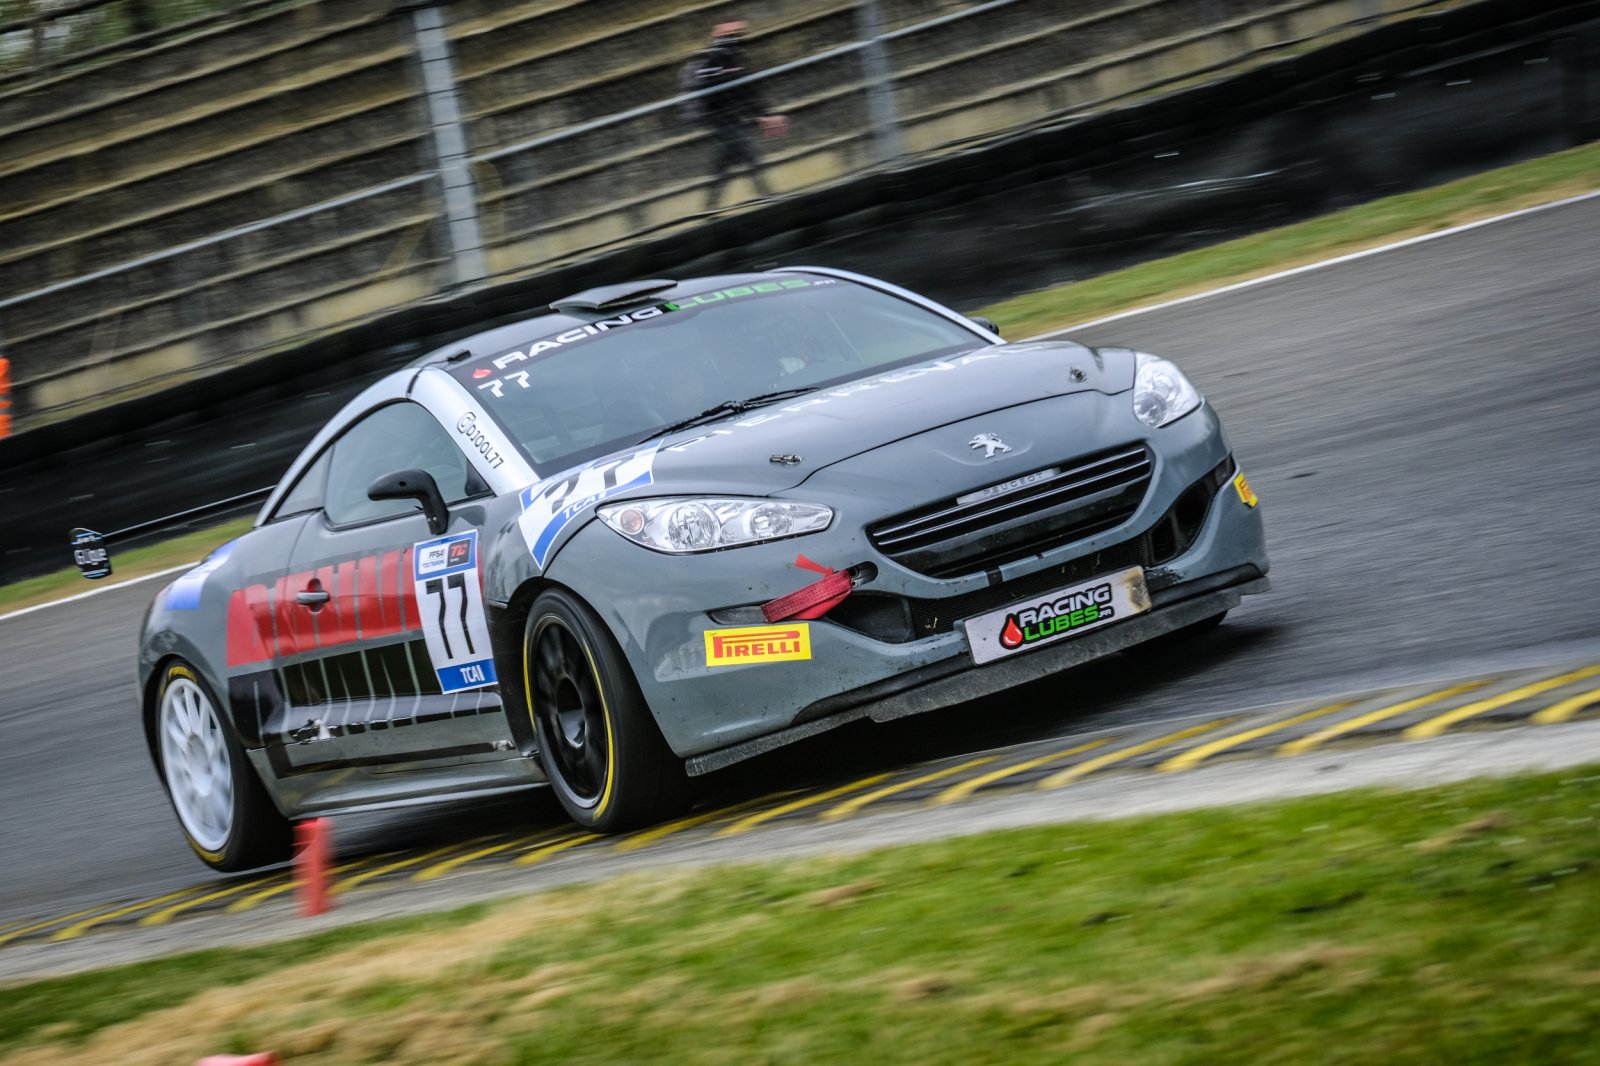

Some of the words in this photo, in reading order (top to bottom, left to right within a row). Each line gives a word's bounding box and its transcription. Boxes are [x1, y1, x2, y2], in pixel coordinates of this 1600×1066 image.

[983, 472, 1042, 496] PEUGEOT
[425, 572, 475, 659] 77
[1020, 585, 1110, 628] RACING
[713, 630, 800, 659] PIRELLI
[460, 664, 485, 684] TCAI
